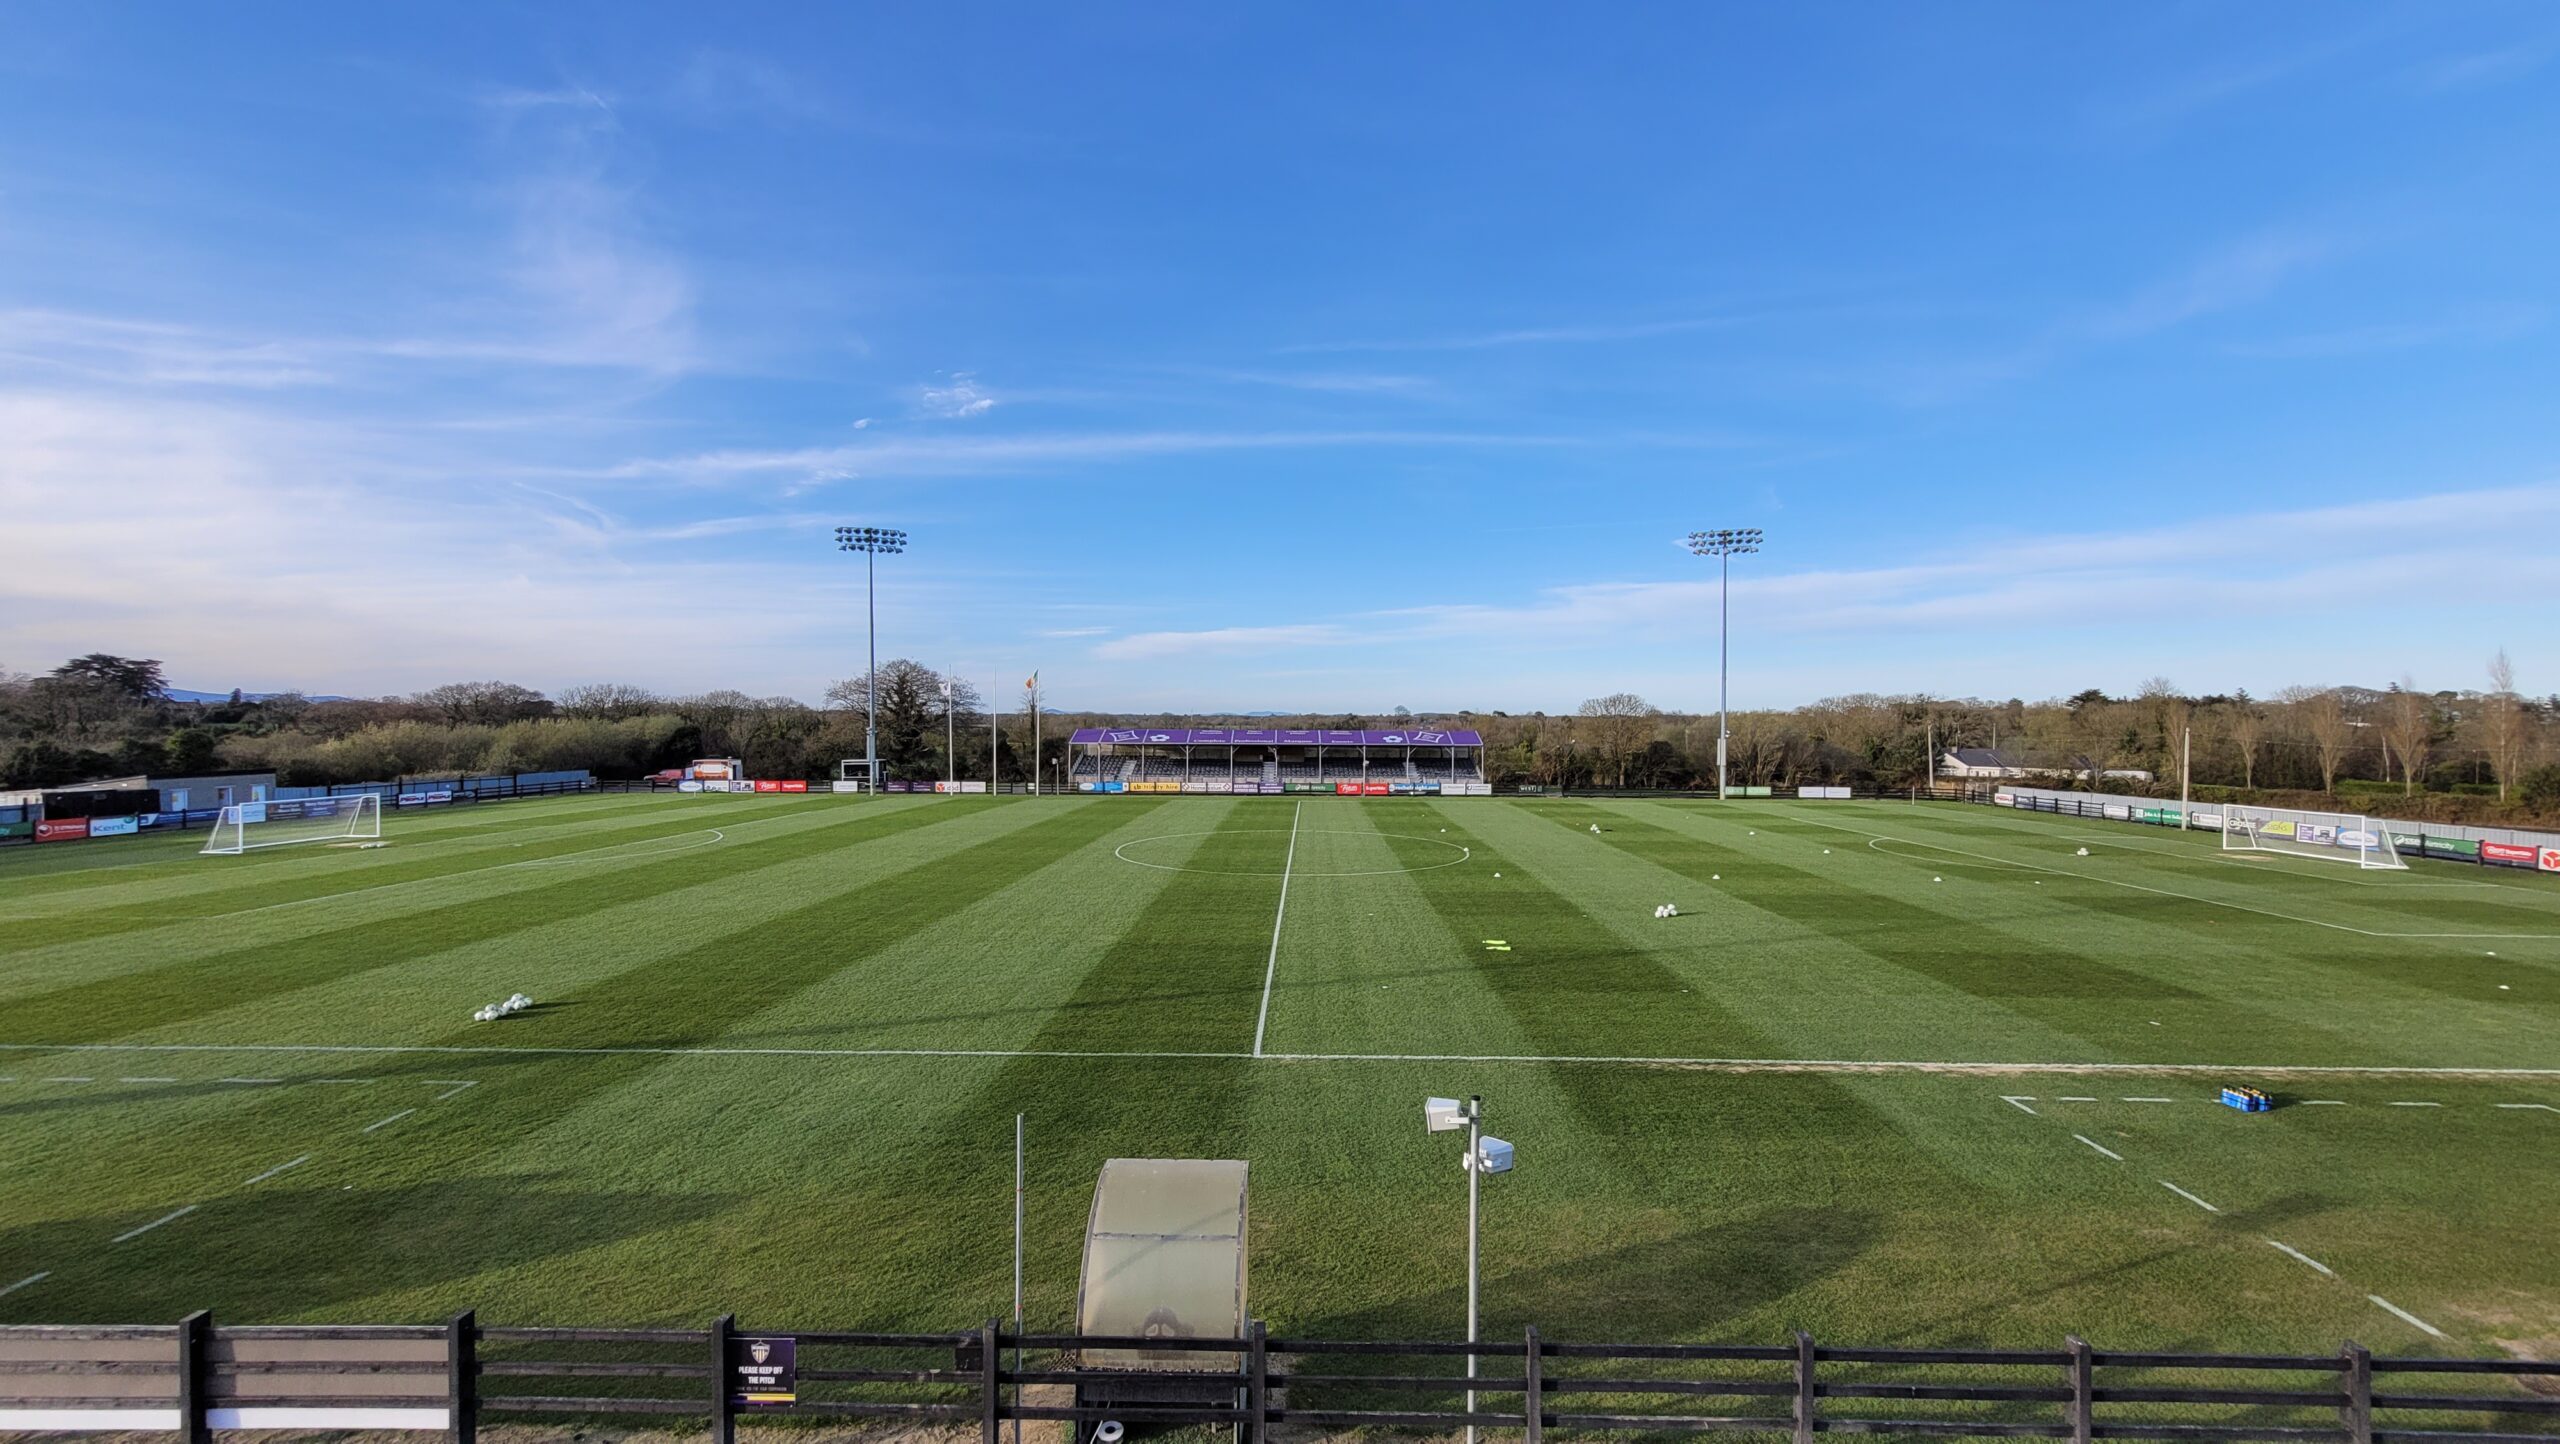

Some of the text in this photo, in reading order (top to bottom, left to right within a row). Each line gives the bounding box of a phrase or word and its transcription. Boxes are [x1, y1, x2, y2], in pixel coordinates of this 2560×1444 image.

[93, 823, 127, 833] Kent
[739, 1366, 783, 1374] PLEASE KEEP OFF
[748, 1376, 775, 1384] THE PITCH
